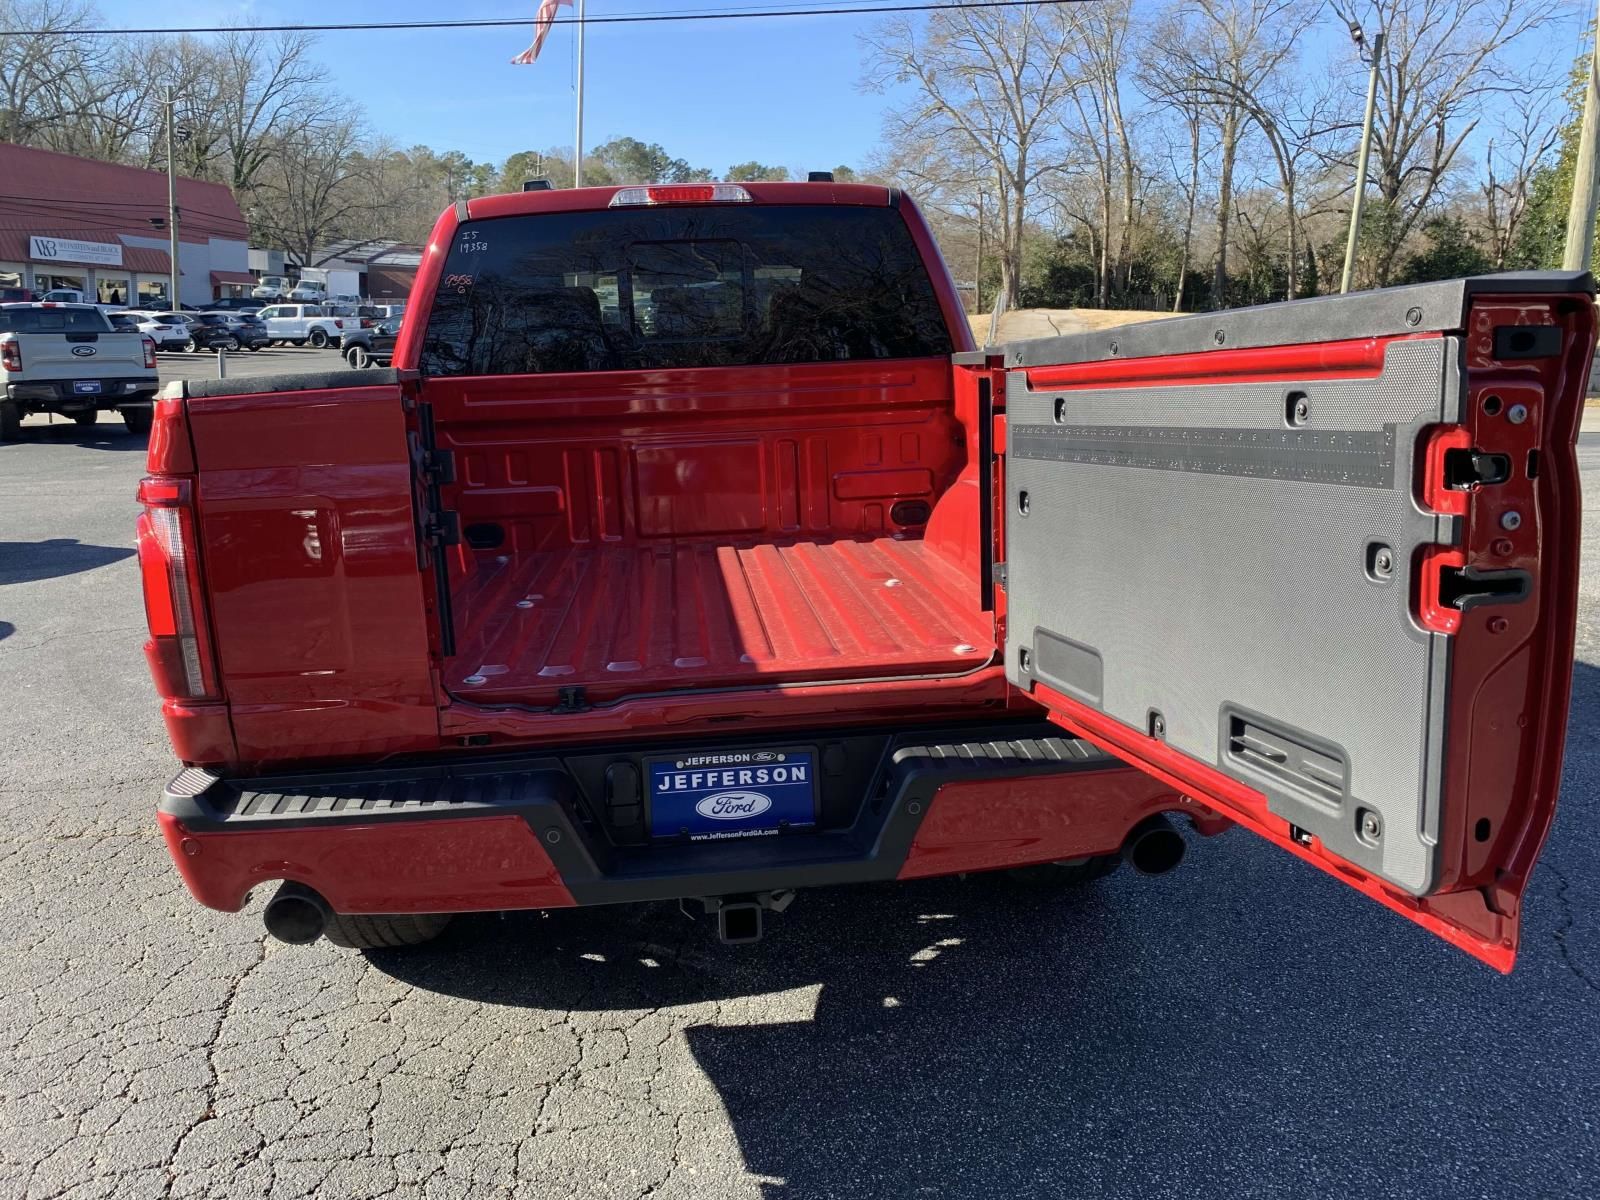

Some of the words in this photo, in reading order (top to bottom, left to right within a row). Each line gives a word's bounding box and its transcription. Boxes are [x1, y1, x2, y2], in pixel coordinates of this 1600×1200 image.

[685, 754, 750, 766] JEFFERSON
[755, 752, 774, 761] Ford
[658, 767, 806, 790] JEFFERSON
[711, 796, 756, 815] Ford
